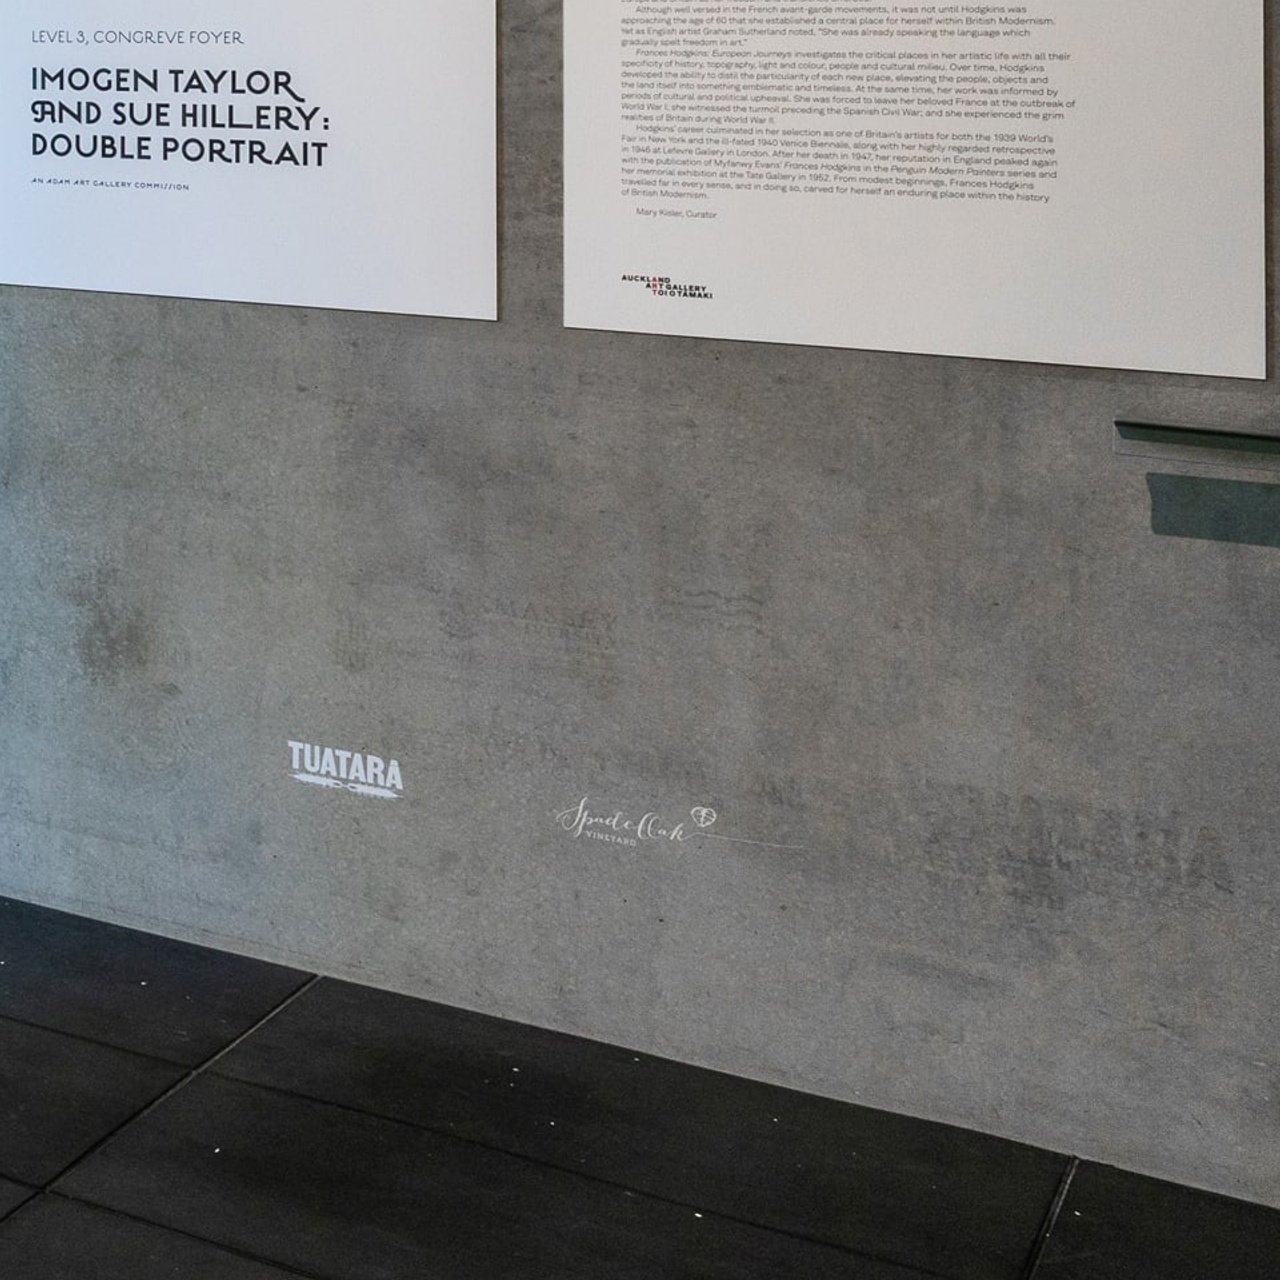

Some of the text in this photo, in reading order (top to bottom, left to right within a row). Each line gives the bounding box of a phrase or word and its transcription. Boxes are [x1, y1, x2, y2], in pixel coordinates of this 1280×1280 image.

[636, 5, 672, 14] Although
[674, 5, 690, 13] well
[693, 5, 721, 13] versed
[732, 5, 746, 13] the
[748, 5, 778, 13] French
[780, 5, 833, 15] avant-garde
[835, 5, 891, 14] movements,
[921, 5, 936, 13] not
[938, 5, 959, 13] until
[961, 5, 1005, 15] Hodgkins
[31, 30, 245, 46] LEVEL 3, CONGREVE FOYER
[31, 67, 305, 103] IMOGEN TAYLOR
[30, 100, 330, 132] AND SUE HILLERY:
[32, 133, 329, 167] DOUBLE PORTRAIT
[46, 178, 71, 186] ADAM
[92, 180, 132, 188] GALLERY
[134, 182, 190, 191] COMMISSION
[631, 188, 658, 197] British
[660, 189, 709, 199] Modernism.
[622, 274, 671, 284] AUCKLAND
[646, 282, 707, 293] ART GALLERY
[287, 739, 404, 791] TUATARA
[556, 794, 685, 842] Spade Oak
[586, 830, 638, 848] VINEYARD
